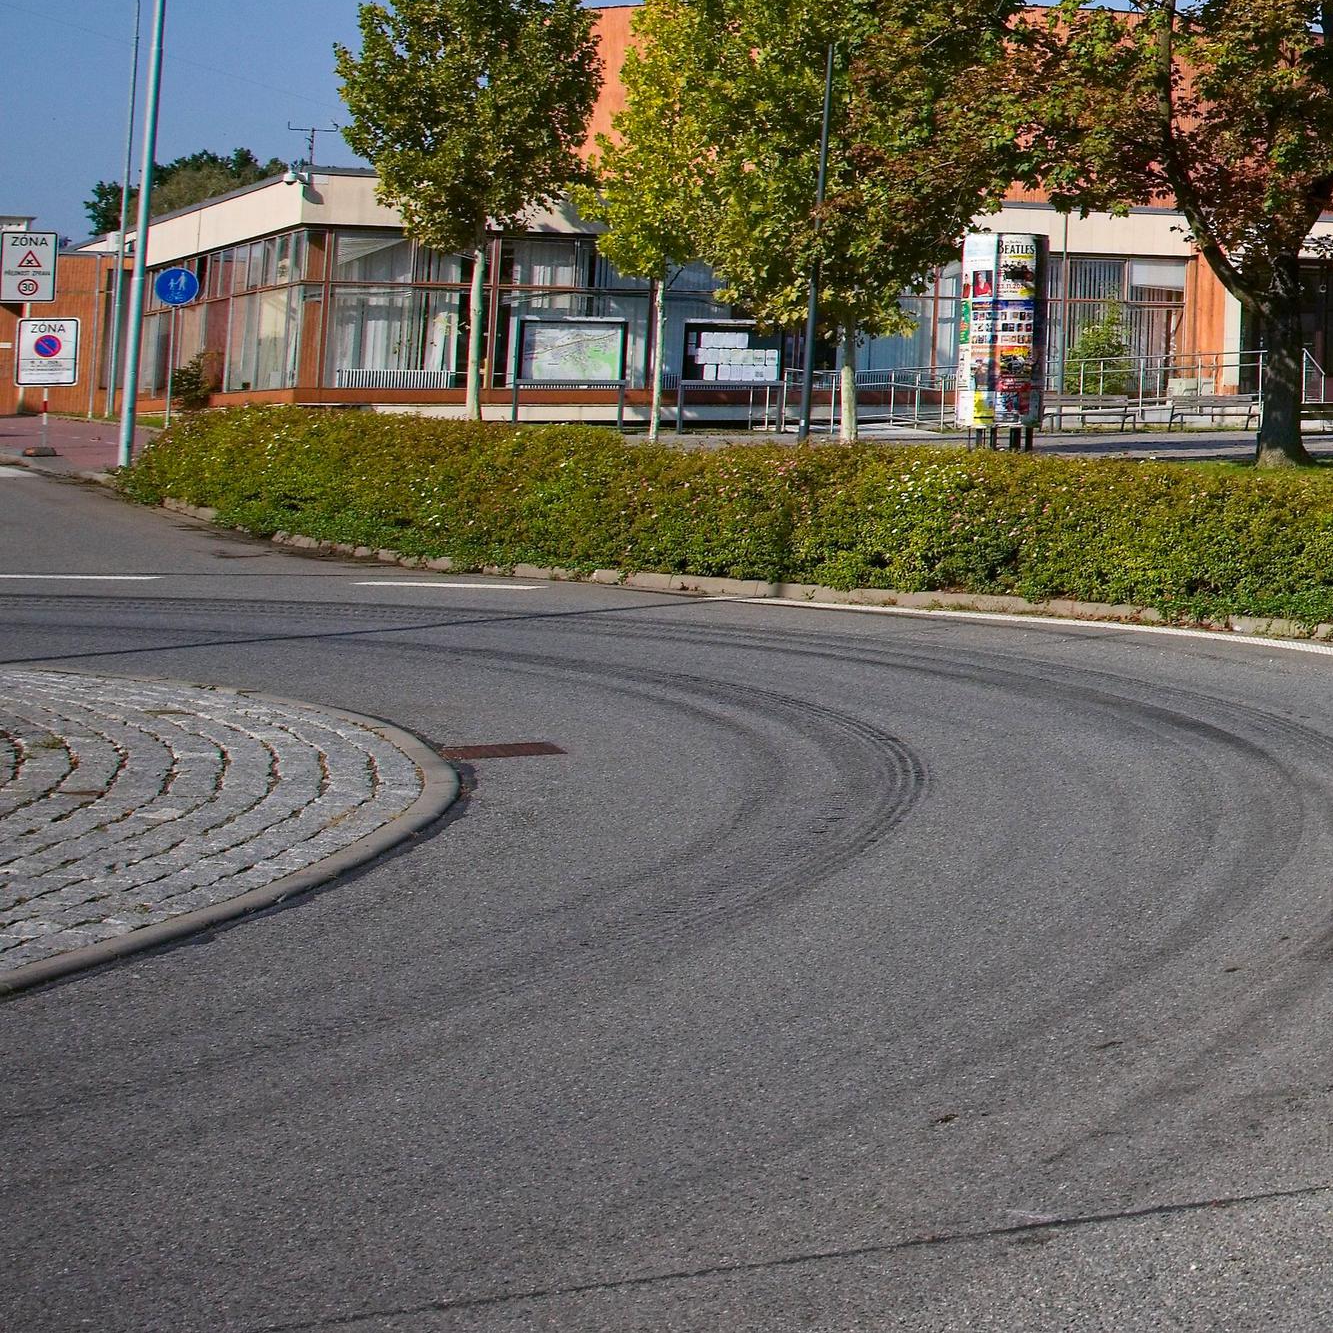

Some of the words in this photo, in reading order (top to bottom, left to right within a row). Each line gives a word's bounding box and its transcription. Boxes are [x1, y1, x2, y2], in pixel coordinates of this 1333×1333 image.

[11, 234, 49, 247] ZÓNA
[997, 239, 1035, 255] BEATLES
[22, 283, 34, 292] 30
[30, 321, 66, 334] ZÓNA
